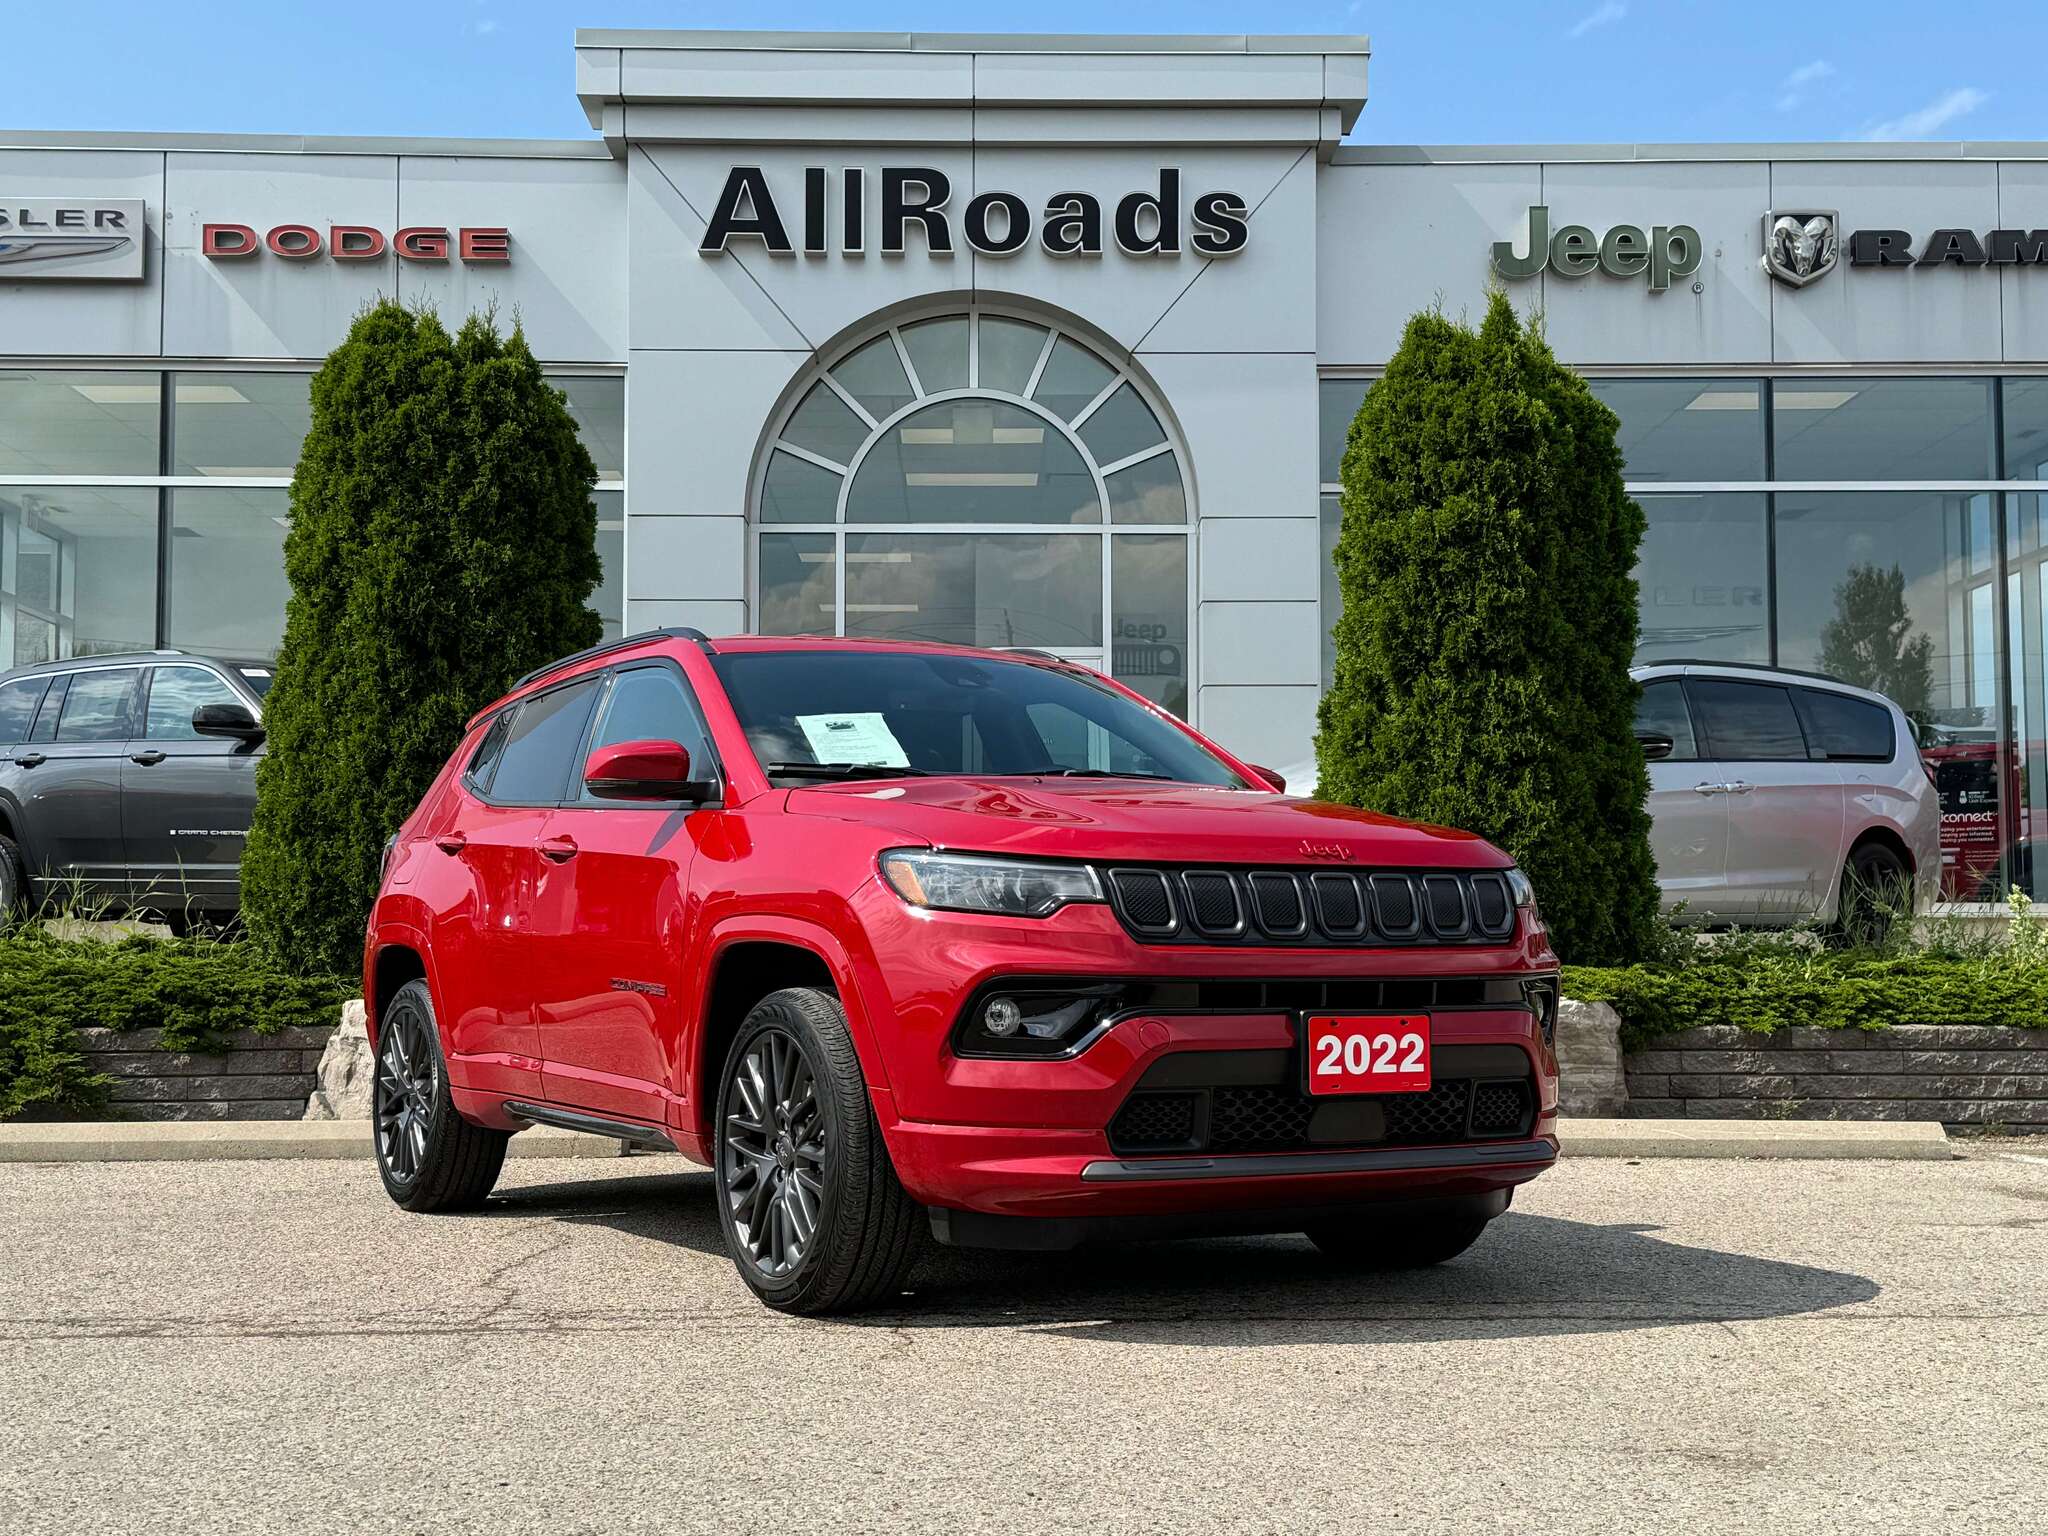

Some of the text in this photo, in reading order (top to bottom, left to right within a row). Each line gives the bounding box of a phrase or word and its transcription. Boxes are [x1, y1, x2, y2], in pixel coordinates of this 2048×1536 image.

[698, 165, 1249, 258] AllRoads
[203, 223, 511, 264] DODGE
[1490, 205, 1704, 294] Jeep
[1850, 229, 2048, 267] RAM
[1299, 840, 1352, 860] Jeep
[1316, 1033, 1425, 1075] 2022
